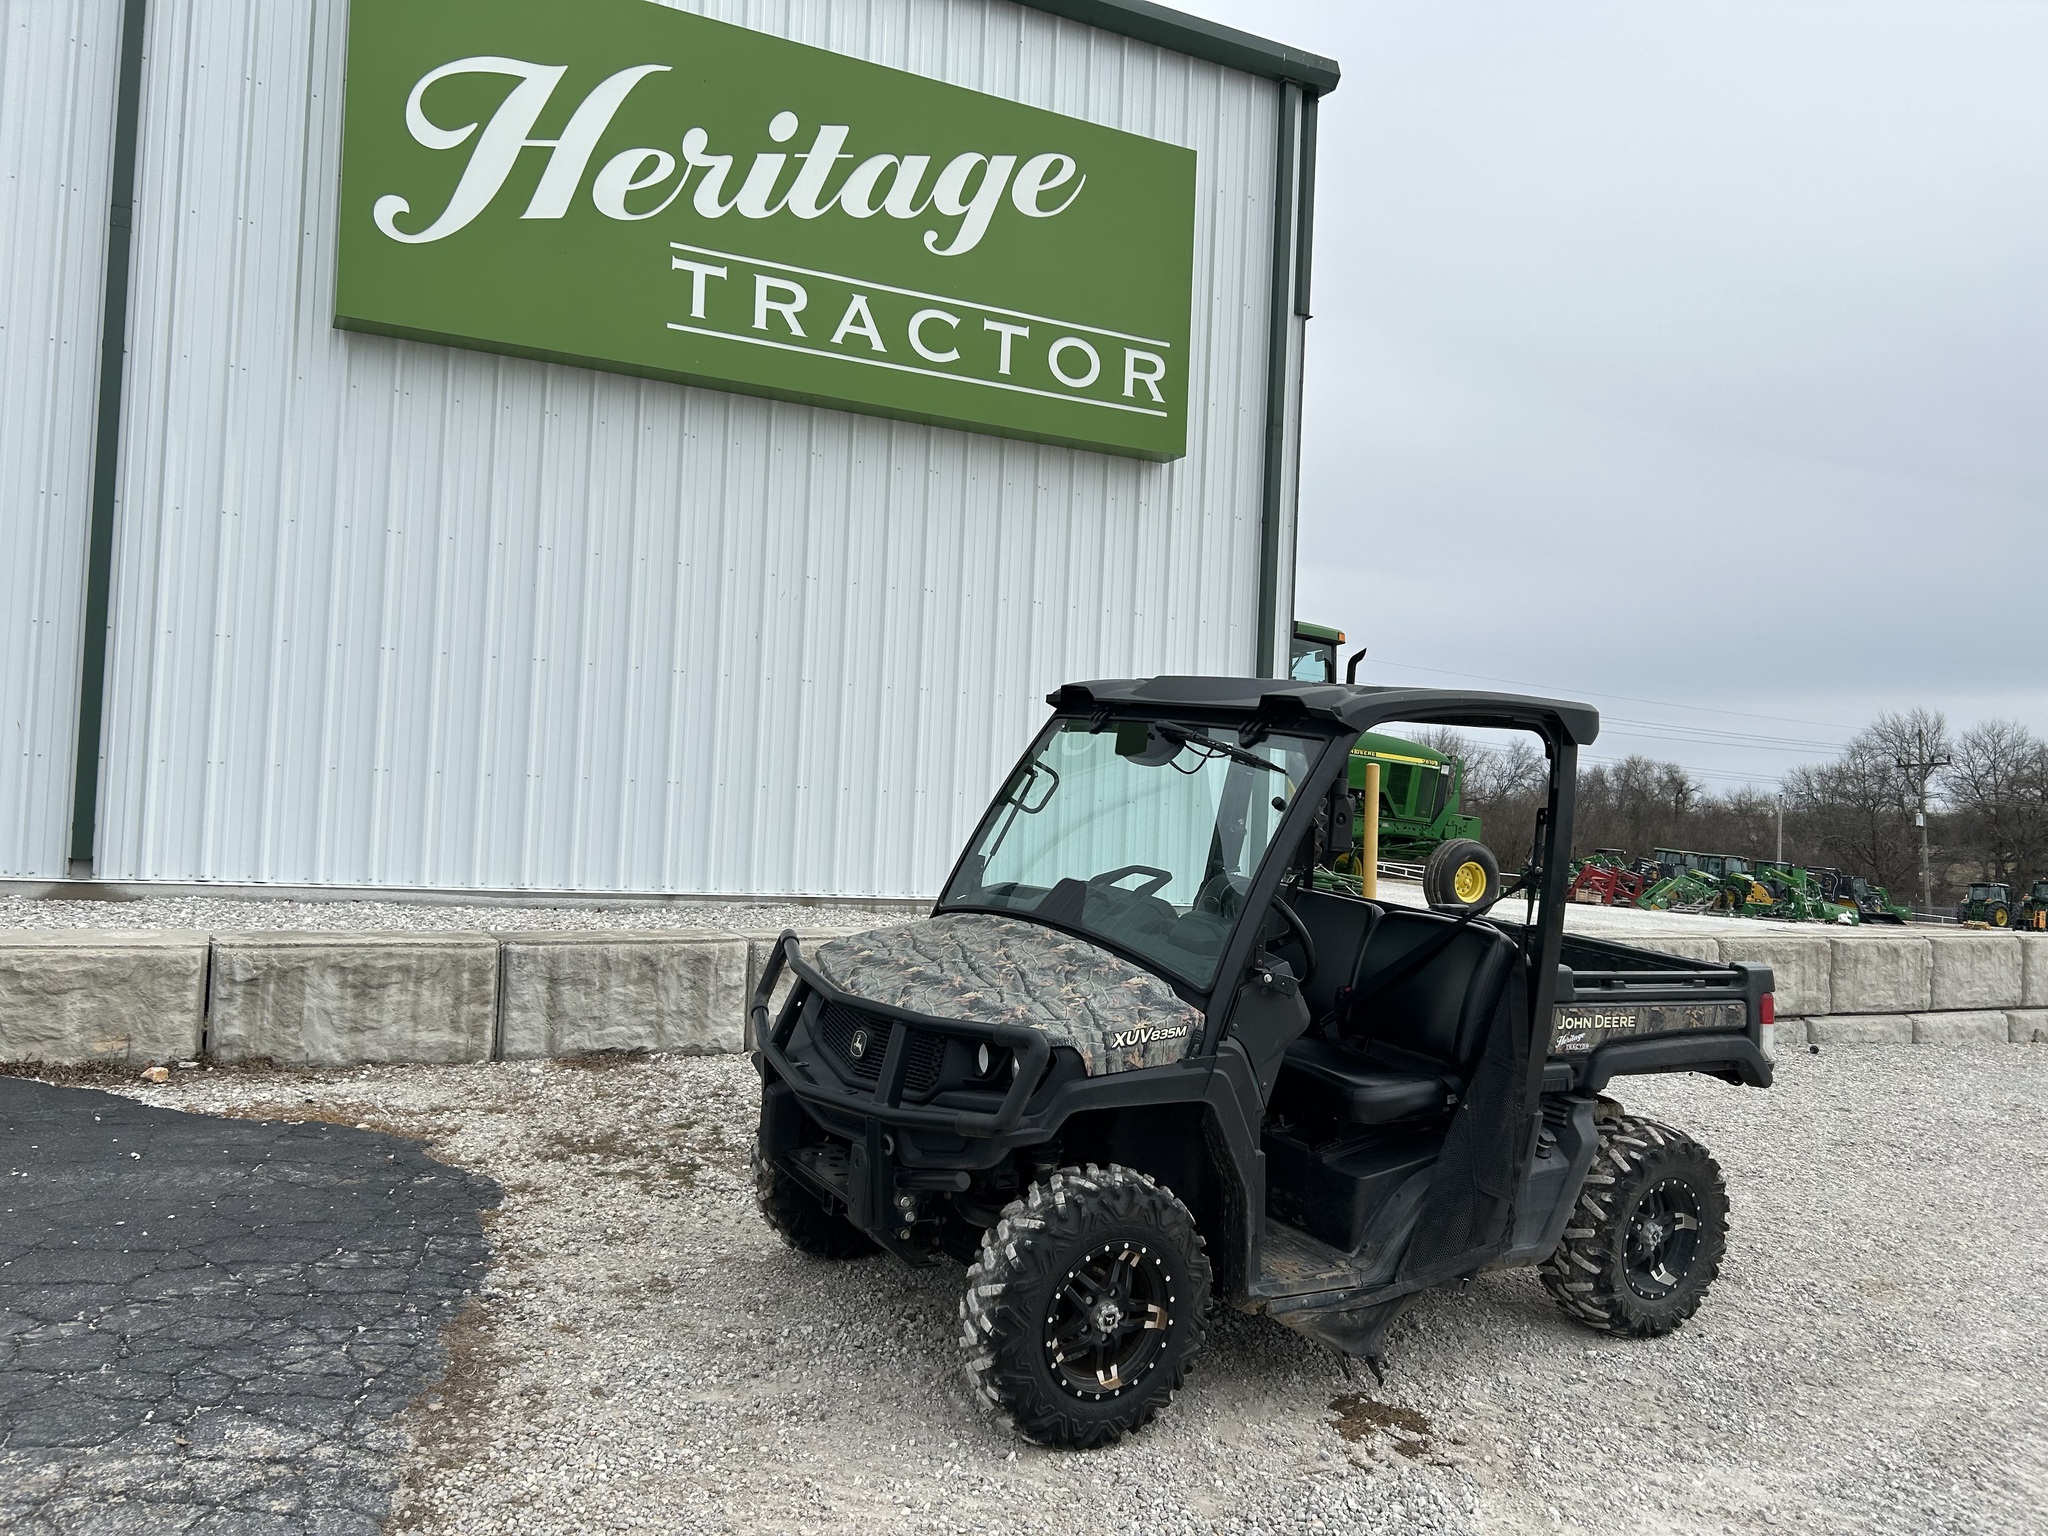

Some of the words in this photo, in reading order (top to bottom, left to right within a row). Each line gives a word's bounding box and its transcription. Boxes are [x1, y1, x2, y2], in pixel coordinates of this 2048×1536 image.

[373, 55, 1087, 257] Heritage
[670, 255, 1168, 404] TRACTOR
[1111, 1025, 1188, 1049] XUV835M
[1557, 1015, 1592, 1029] JOHN
[1594, 1014, 1636, 1029] DEERE
